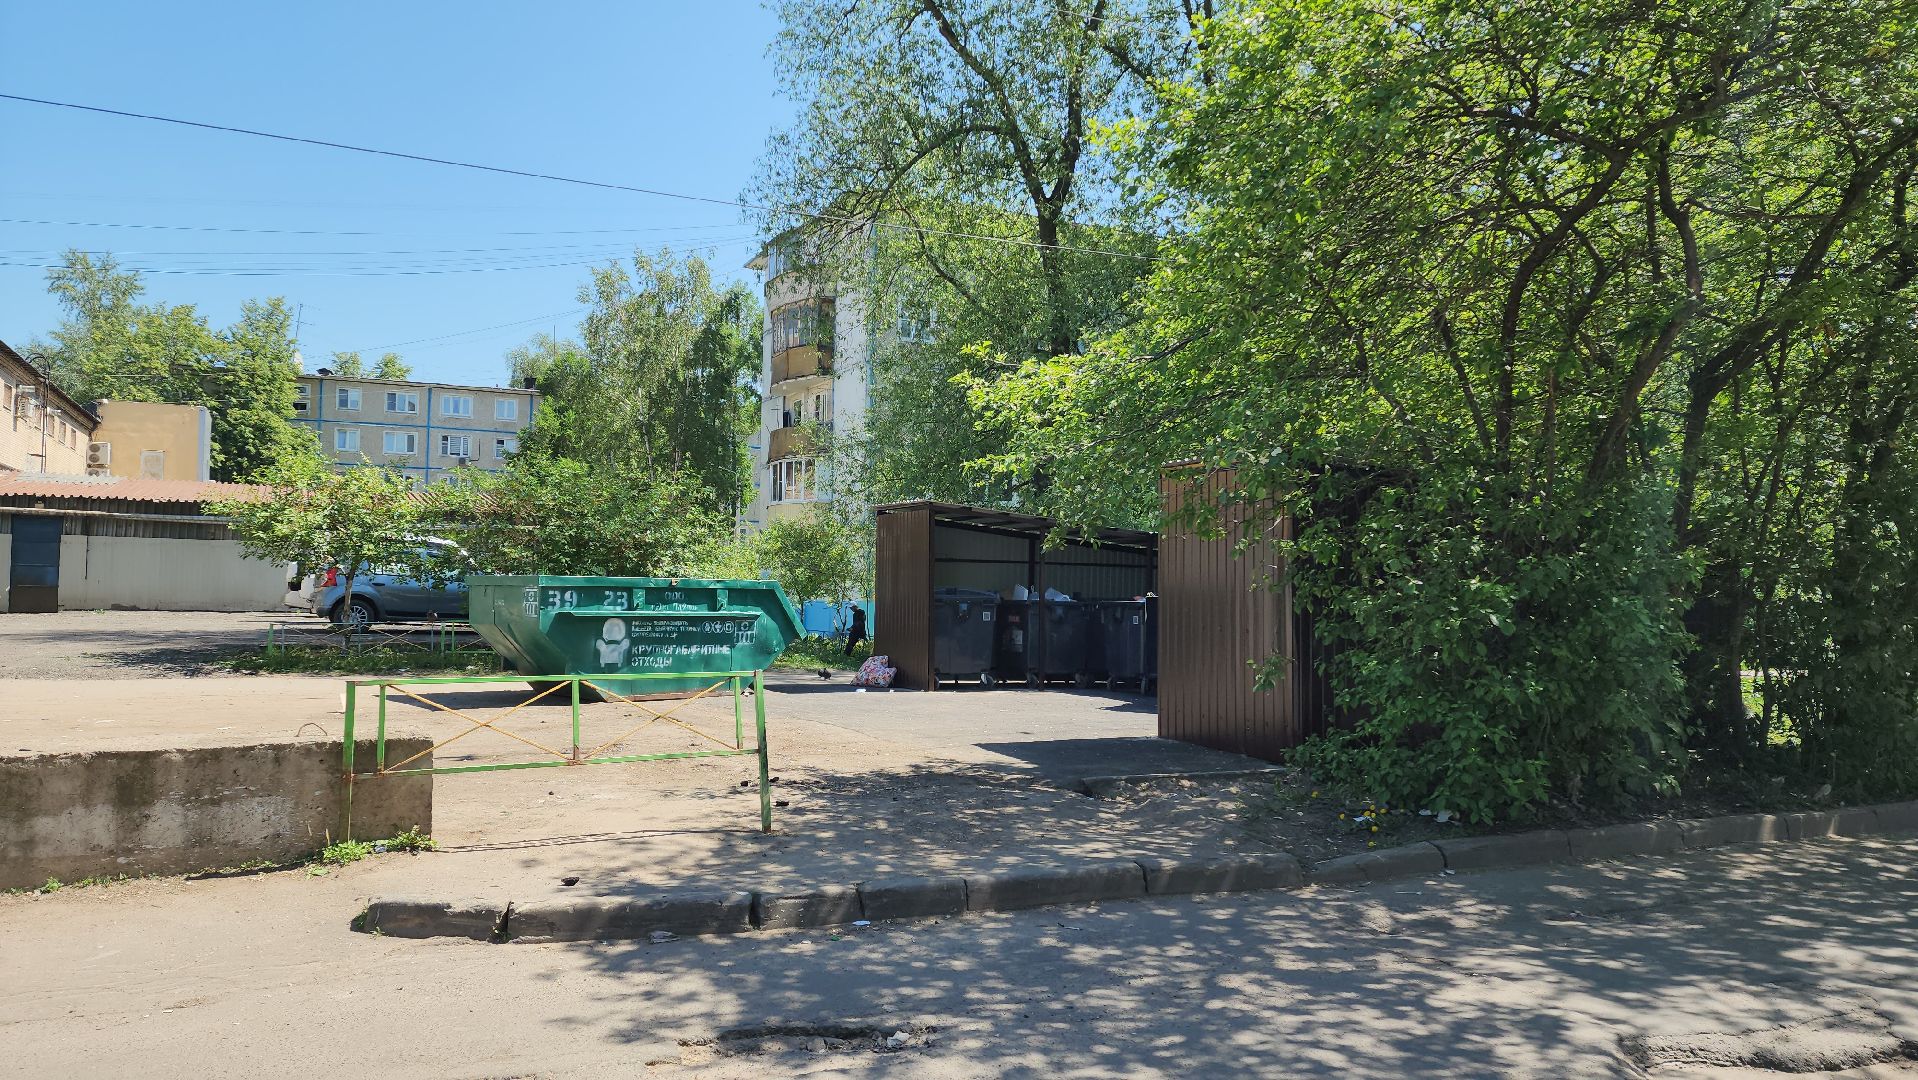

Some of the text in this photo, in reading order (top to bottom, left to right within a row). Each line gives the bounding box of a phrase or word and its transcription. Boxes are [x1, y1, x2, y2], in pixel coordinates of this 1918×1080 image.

[548, 590, 577, 610] 39
[604, 590, 628, 611] 23
[631, 644, 731, 655] КРУПНОГАБАРИТНЫЕ
[631, 656, 673, 668] ОТХОДЫ
